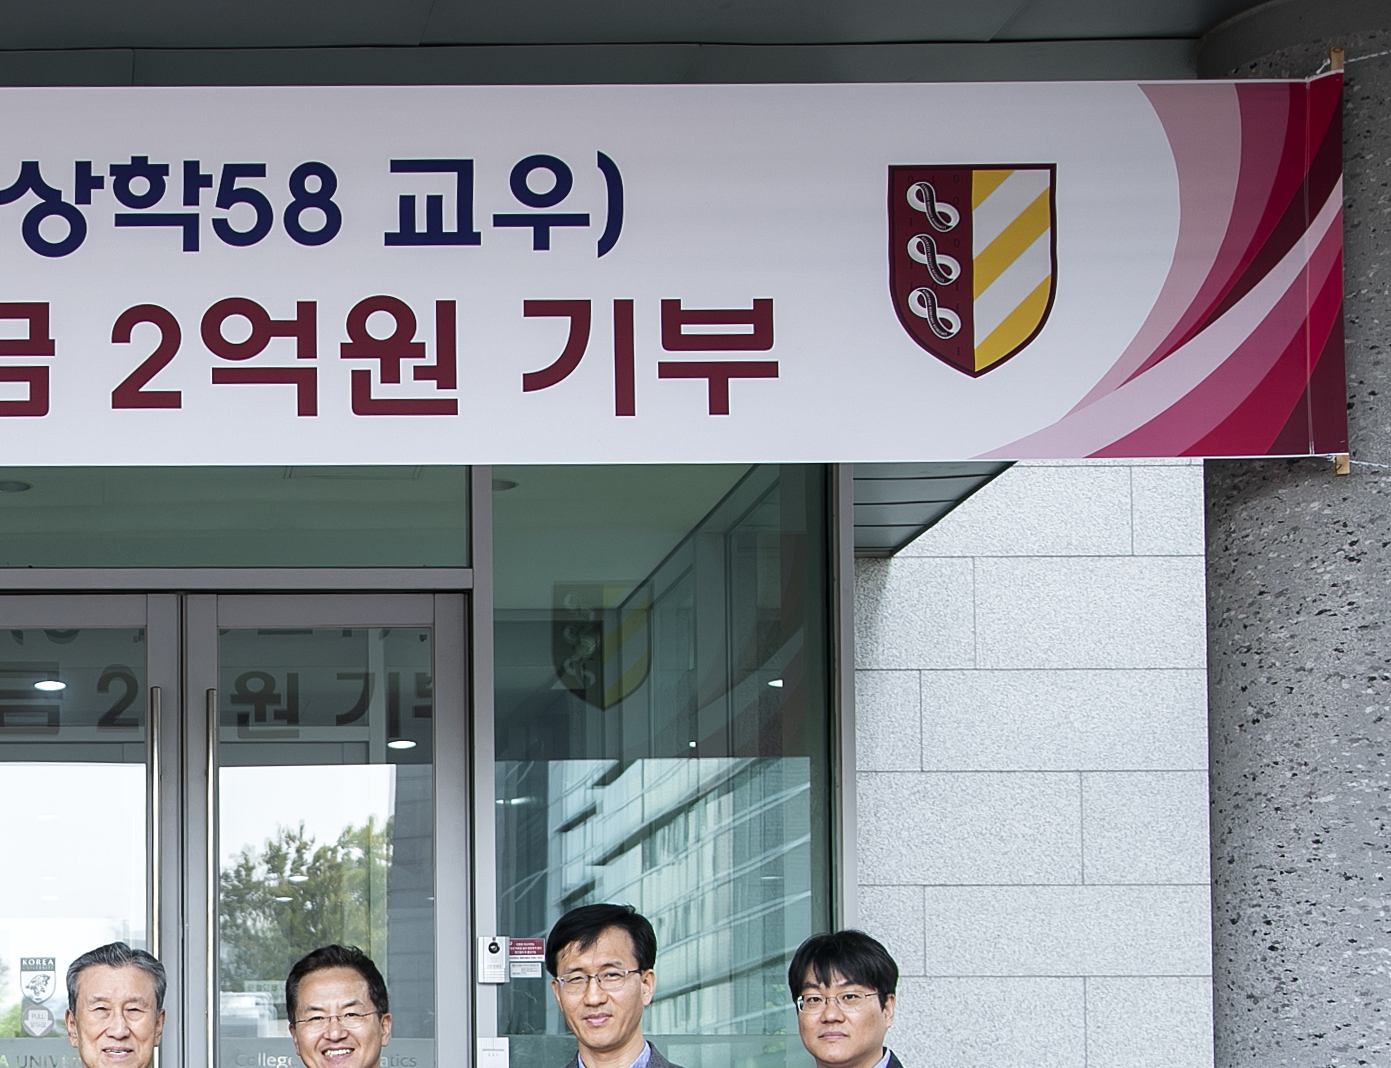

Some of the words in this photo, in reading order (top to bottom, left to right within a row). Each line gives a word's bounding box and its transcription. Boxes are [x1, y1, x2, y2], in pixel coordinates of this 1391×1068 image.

[385, 150, 624, 259] 교우)
[112, 296, 458, 416] 2억원
[523, 299, 778, 416] 기부
[22, 958, 54, 966] KOREA
